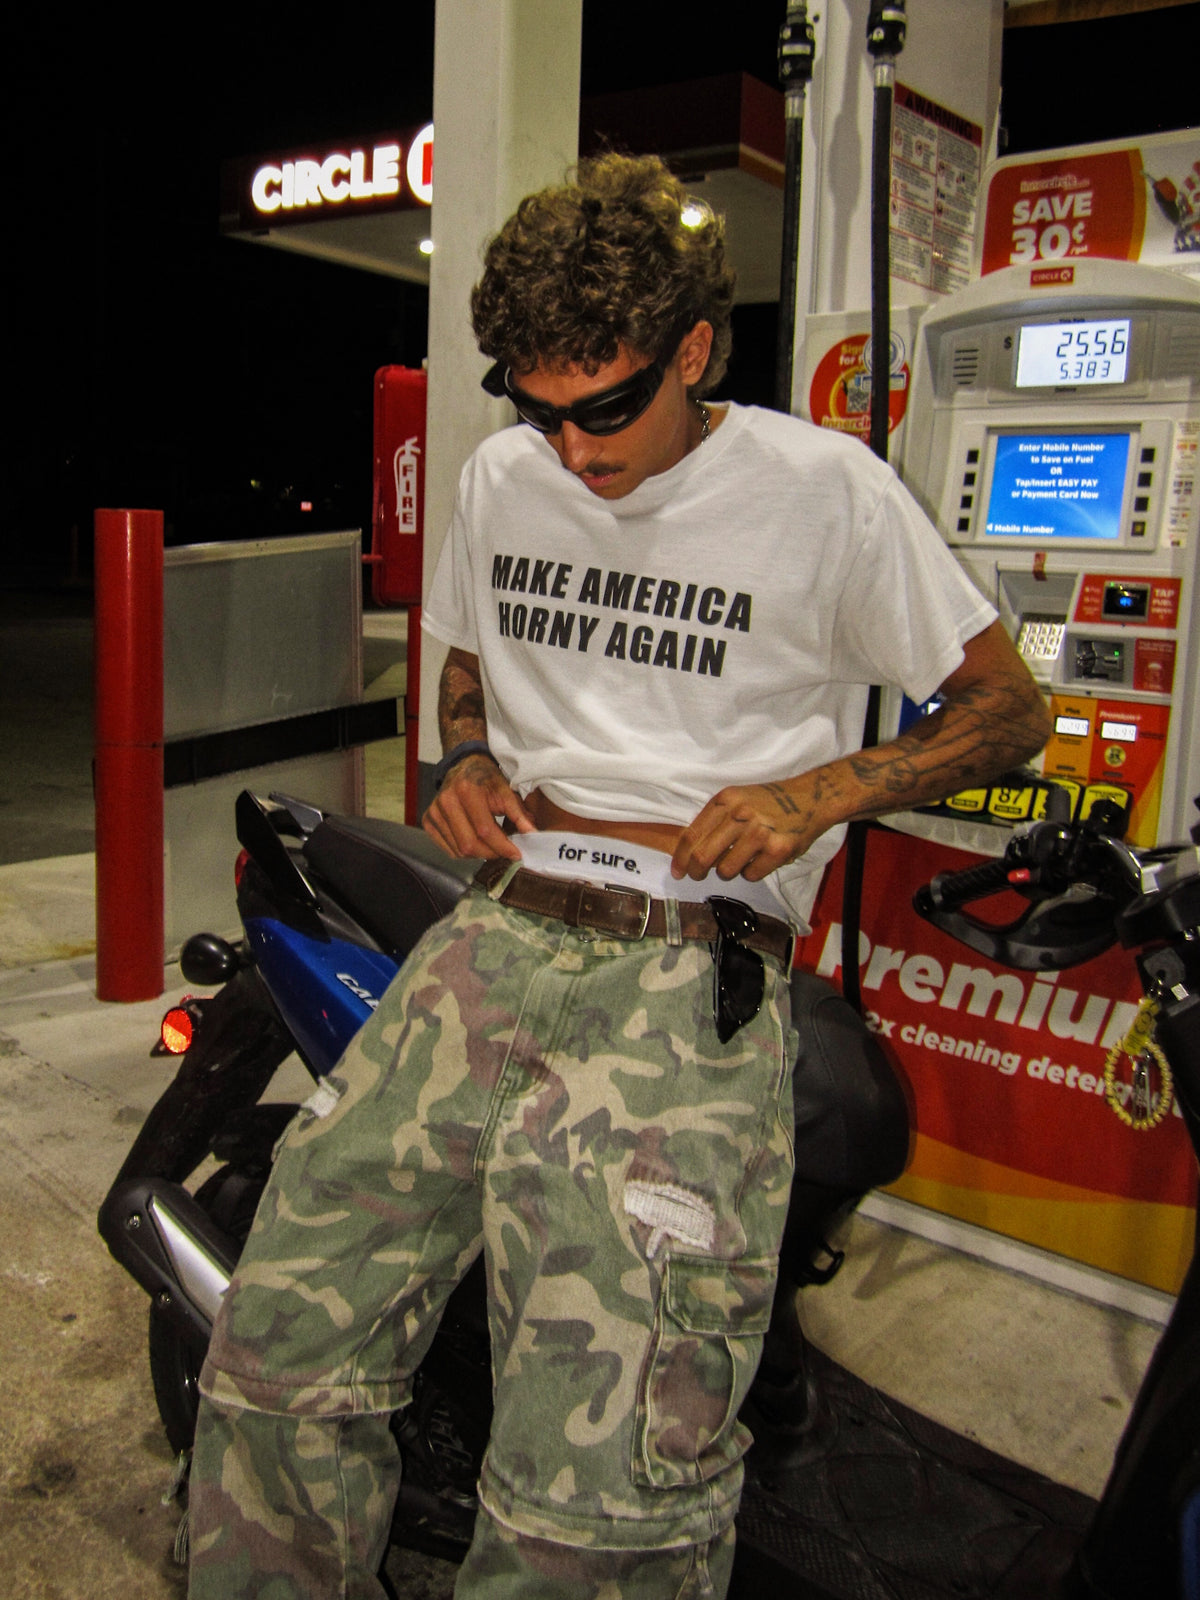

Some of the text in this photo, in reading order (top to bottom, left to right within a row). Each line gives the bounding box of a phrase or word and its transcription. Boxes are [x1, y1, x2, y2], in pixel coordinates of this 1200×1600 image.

[252, 143, 400, 212] CIRCLE
[1012, 191, 1093, 226] SAVE
[1033, 272, 1059, 282] CIRCLE
[1003, 336, 1012, 350] $
[1056, 328, 1126, 358] 25.56
[1060, 360, 1111, 380] 5.383
[1019, 443, 1104, 452] Enter Mobile Number
[1031, 455, 1040, 463] to
[1041, 455, 1061, 464] Save
[1075, 455, 1093, 463] Fuel
[1050, 467, 1062, 475] OR
[1015, 478, 1098, 488] Tap/Insert EASY PAY
[402, 464, 413, 525] FIRE
[1022, 490, 1057, 500] Payment
[1059, 490, 1079, 499] Card
[1080, 491, 1099, 499] Now
[994, 524, 1054, 534] Mobile Number
[491, 554, 752, 633] MAKE AMERICA
[1154, 588, 1174, 598] TAP
[499, 601, 727, 678] HORNY AGAIN
[998, 786, 1025, 804] 87
[558, 844, 641, 874] for sure.
[866, 1010, 895, 1038] 2x
[900, 1024, 1021, 1076] cleaning
